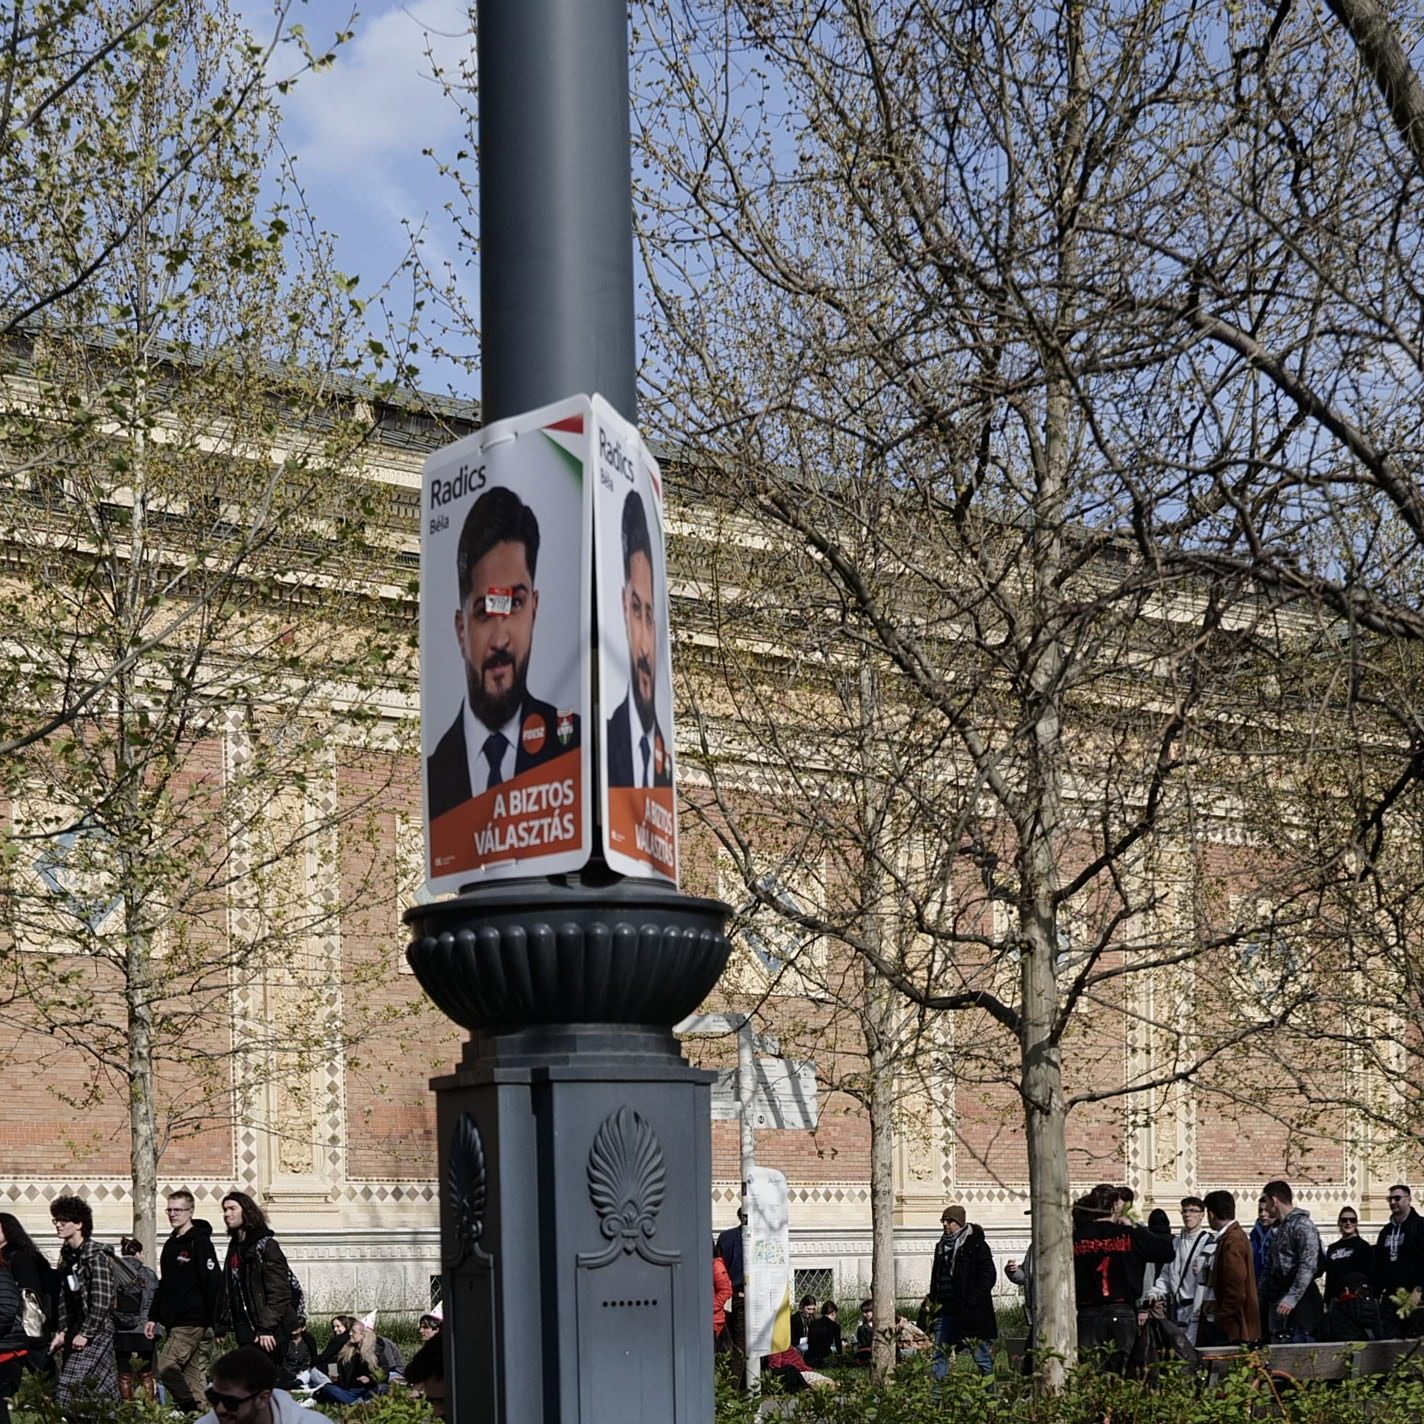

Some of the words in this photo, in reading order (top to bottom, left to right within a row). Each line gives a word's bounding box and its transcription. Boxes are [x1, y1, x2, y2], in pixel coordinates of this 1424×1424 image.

[599, 426, 634, 484] Radics
[431, 465, 486, 510] Radics
[493, 793, 507, 820] A
[509, 778, 574, 817] BIZTOS
[645, 797, 651, 822] A
[474, 808, 575, 856] VÁLASZTÁS
[1096, 1256, 1111, 1297] 1
